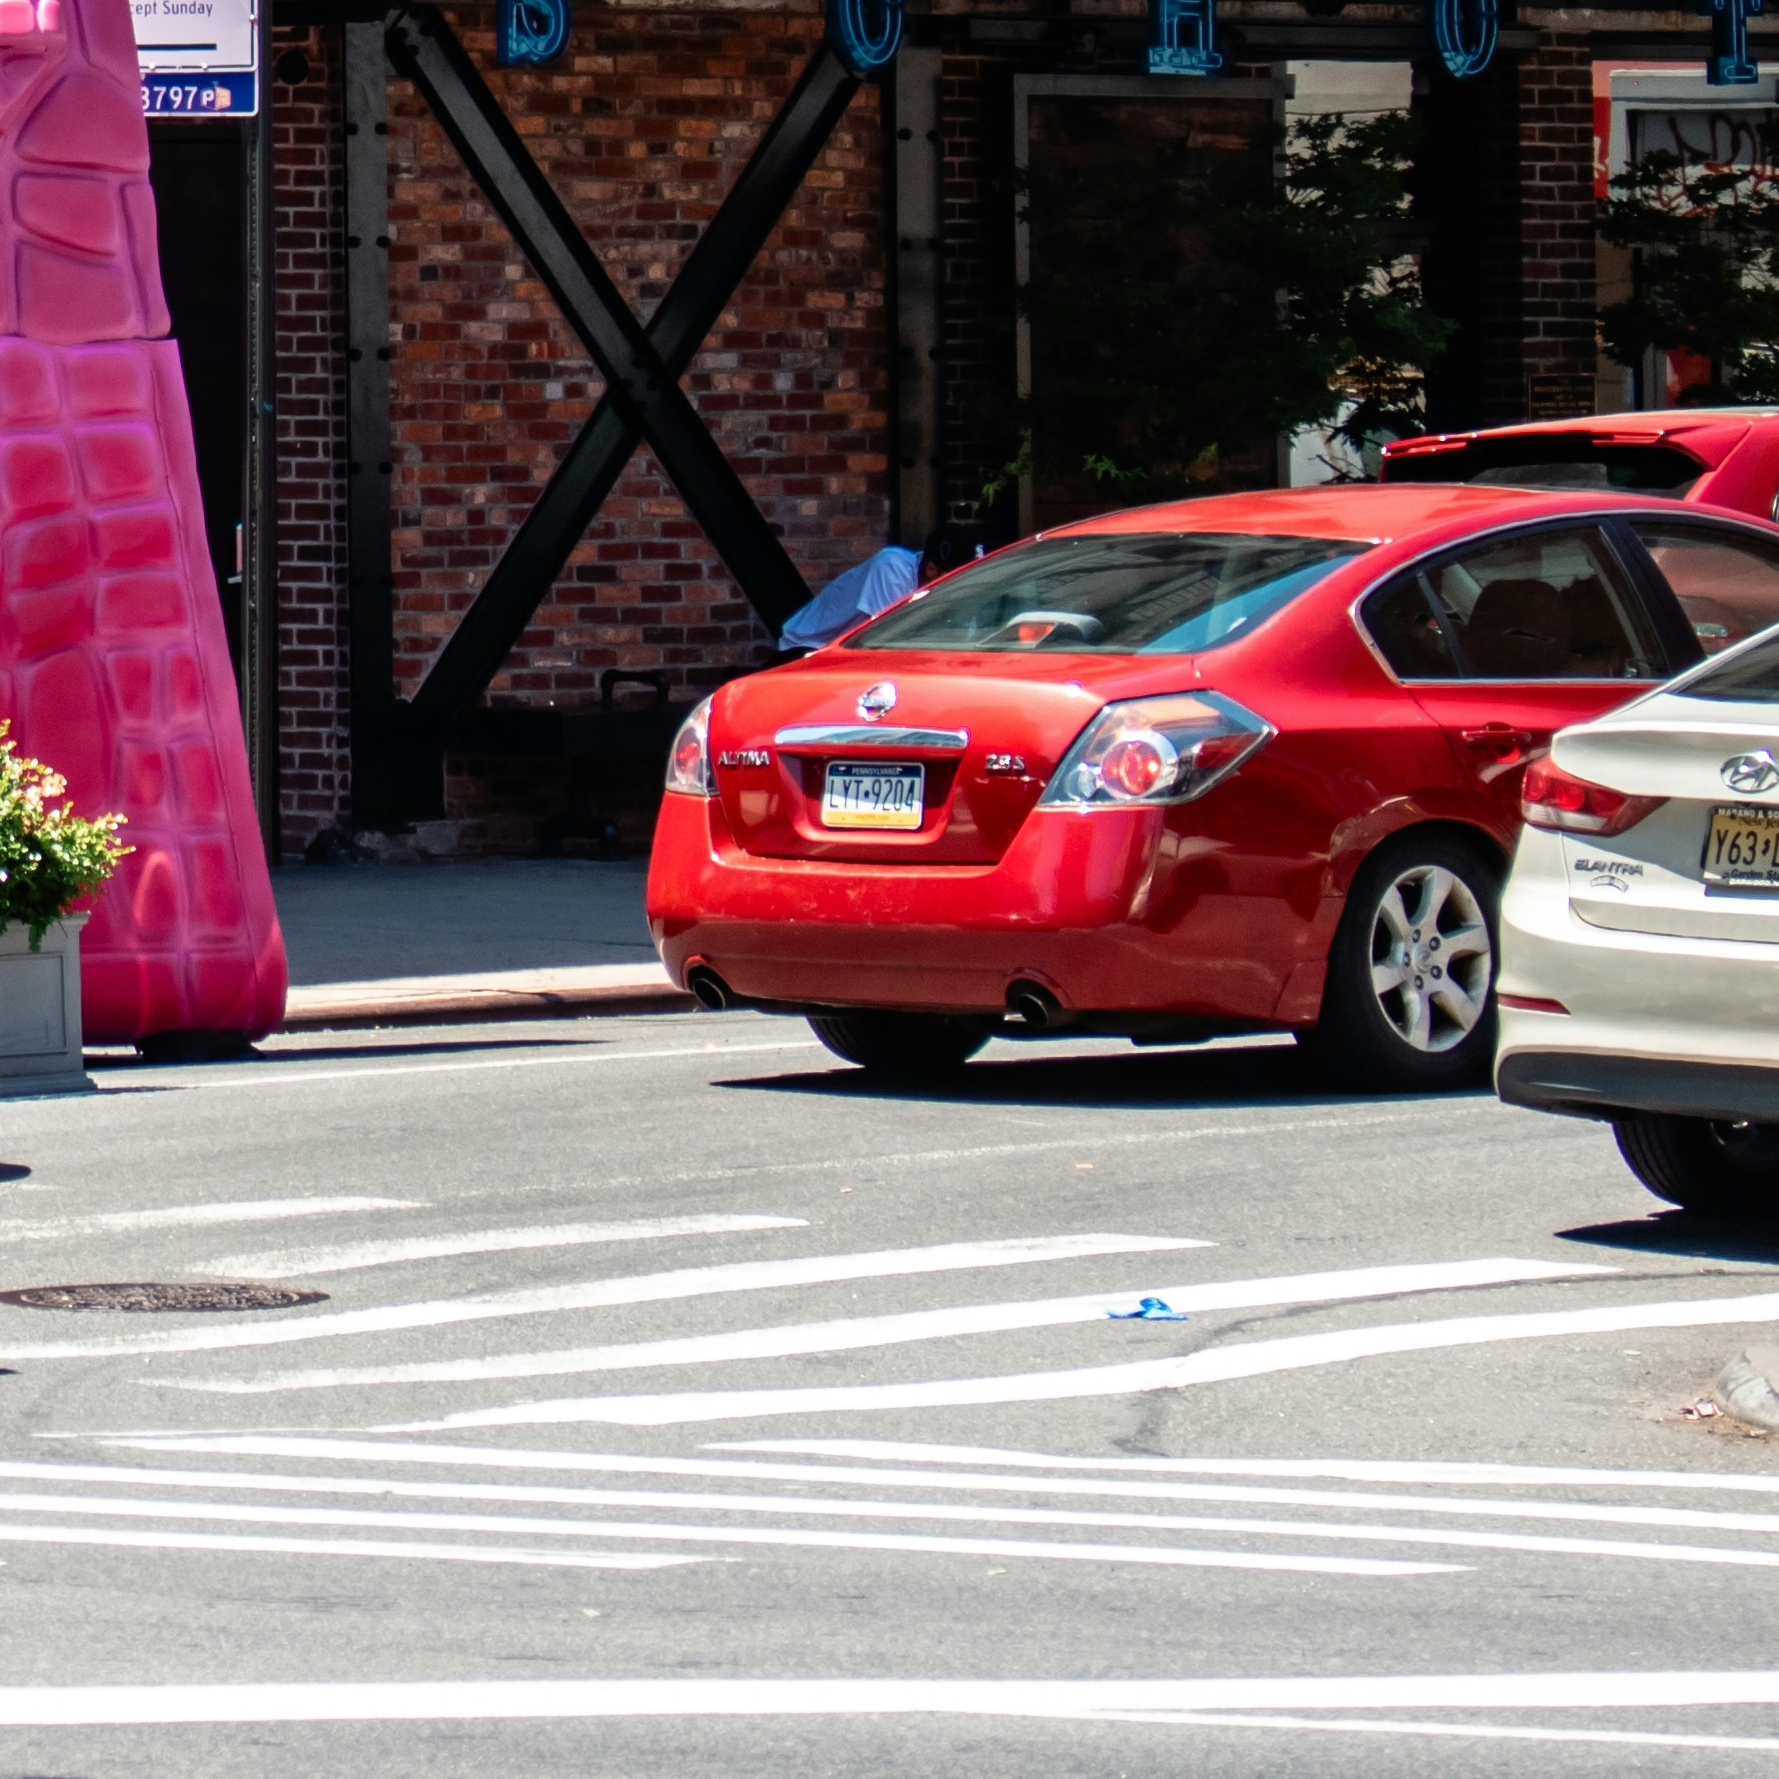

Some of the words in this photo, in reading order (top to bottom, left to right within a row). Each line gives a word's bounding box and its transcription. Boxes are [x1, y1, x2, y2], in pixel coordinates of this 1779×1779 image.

[162, 0, 213, 17] Sunday
[718, 751, 770, 766] ALTIMA
[1574, 859, 1644, 877] ELANTRA
